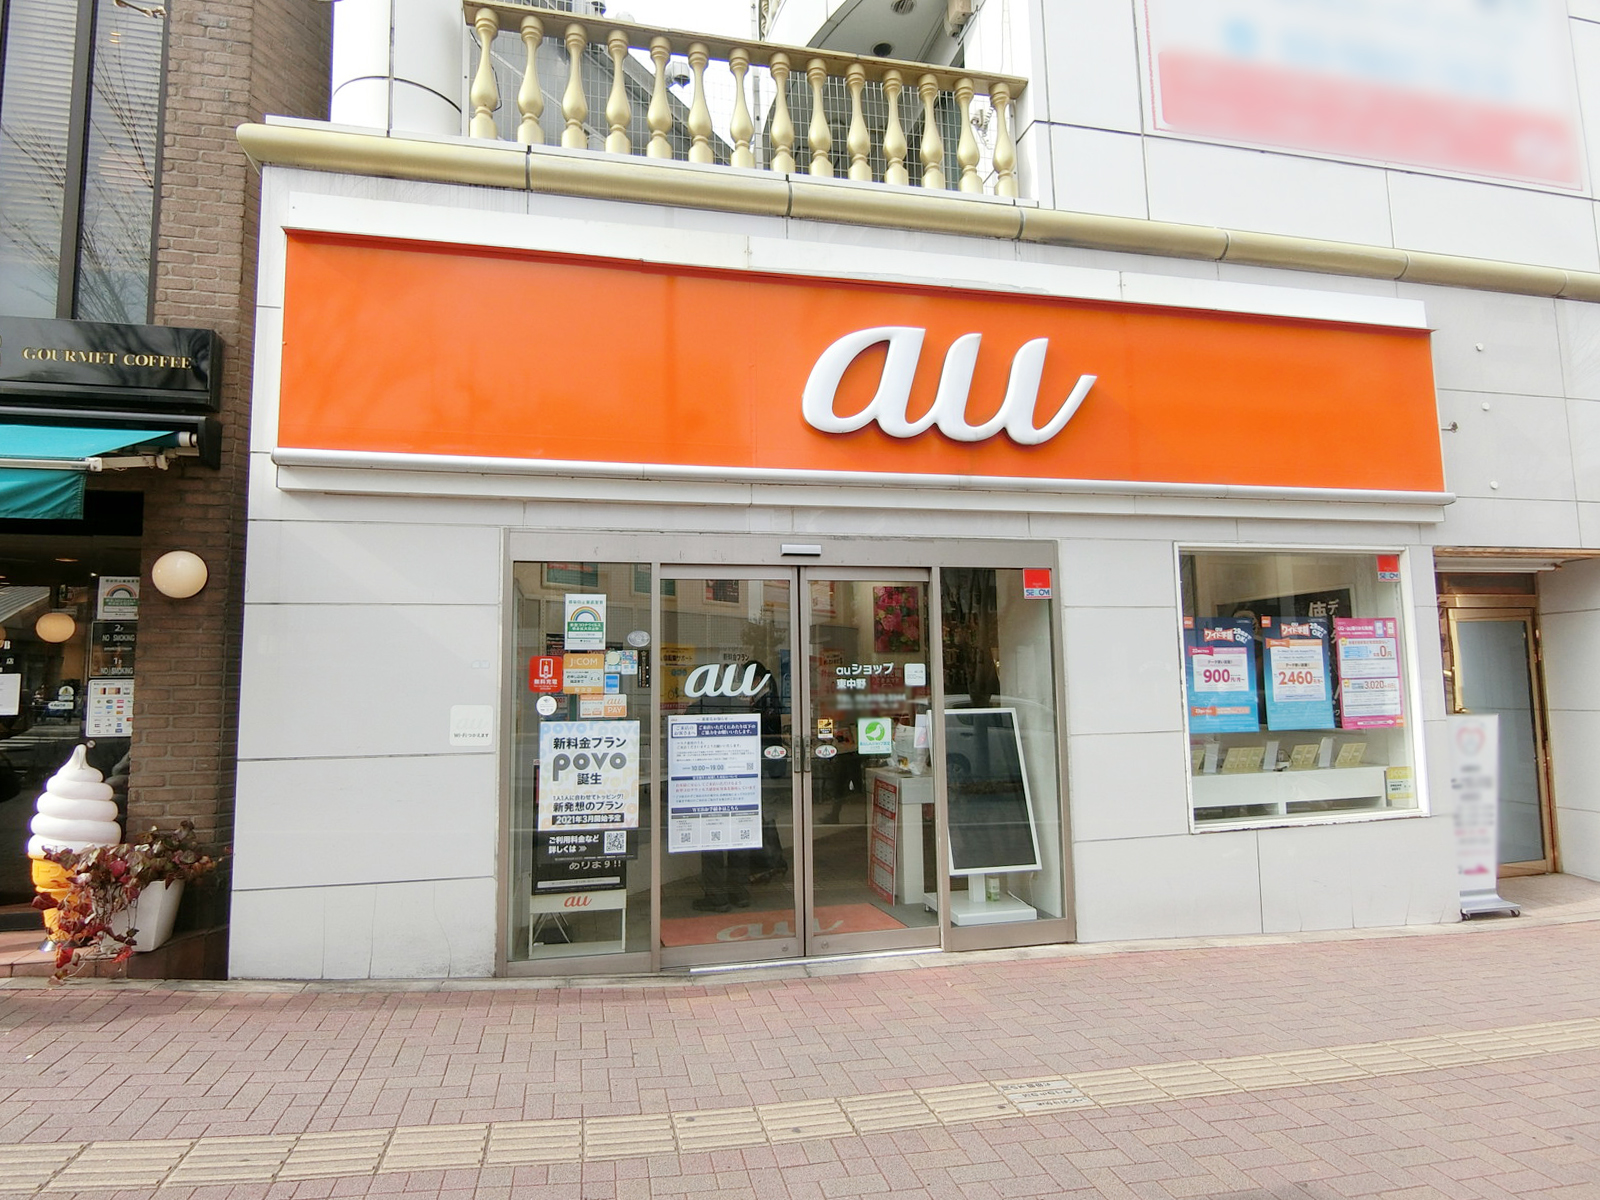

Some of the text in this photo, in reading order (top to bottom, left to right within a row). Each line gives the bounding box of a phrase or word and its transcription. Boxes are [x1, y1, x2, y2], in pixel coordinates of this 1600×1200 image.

[22, 347, 192, 369] GOURMET COFFEE
[802, 326, 1097, 446] au
[1025, 588, 1051, 596] SECOM
[835, 662, 895, 676] auショップ
[684, 663, 772, 698] au
[836, 678, 867, 690] 東中野
[553, 737, 627, 750] 新料金プラン
[552, 752, 628, 782] povo
[577, 772, 603, 786] 誕生
[552, 801, 624, 813] 新発想のプラン
[556, 813, 622, 825] 2021年3月開始予定
[548, 834, 600, 844] ご利用料金など
[548, 845, 577, 854] 詳しくは
[563, 895, 592, 908] au
